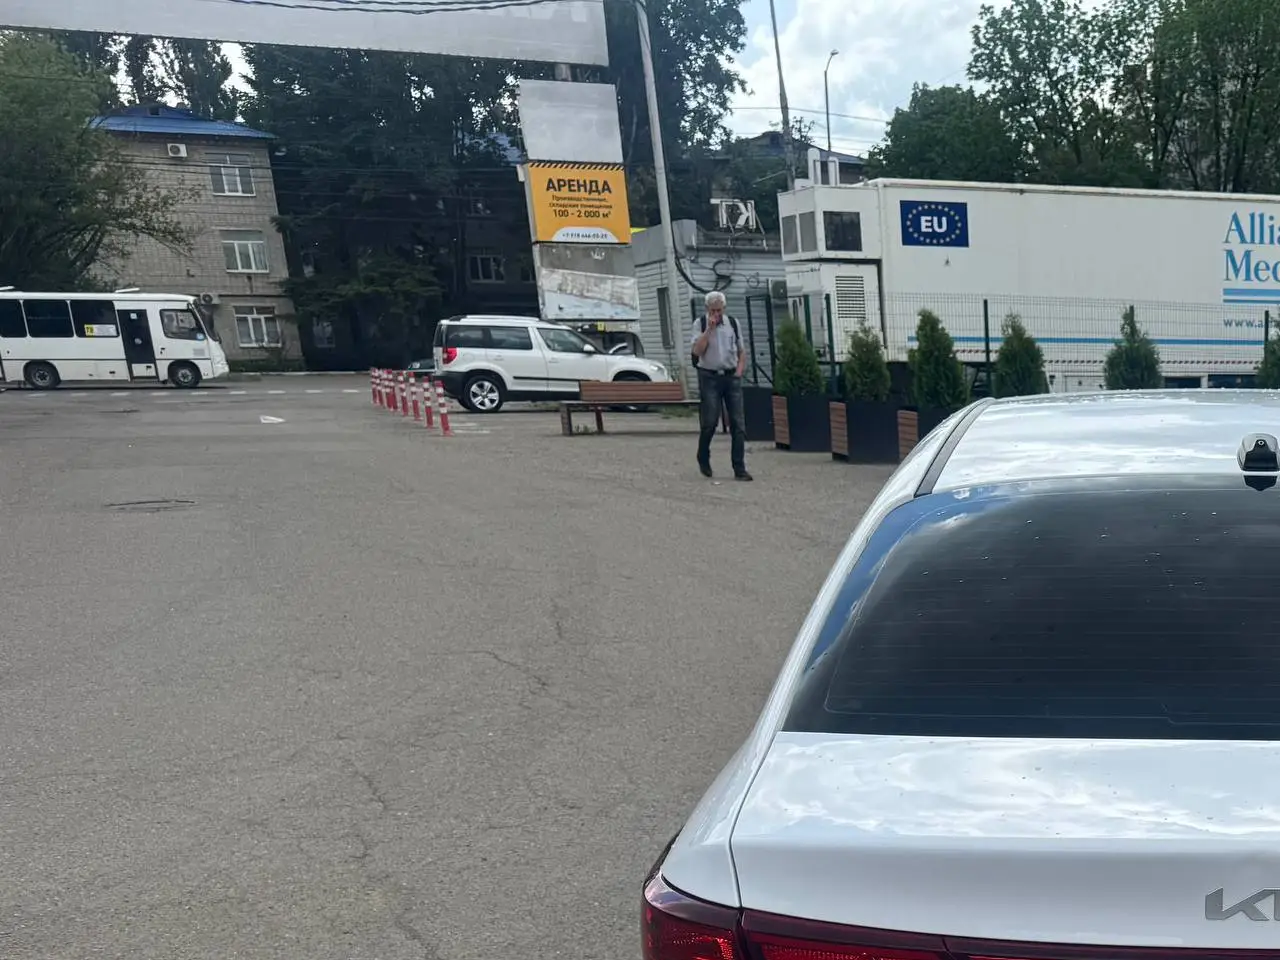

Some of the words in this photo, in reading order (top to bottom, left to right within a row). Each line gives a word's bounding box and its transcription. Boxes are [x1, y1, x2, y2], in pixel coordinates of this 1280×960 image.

[546, 178, 612, 195] АРЕНДА
[553, 208, 570, 218] 100
[584, 209, 601, 219] 000
[920, 215, 948, 233] EU
